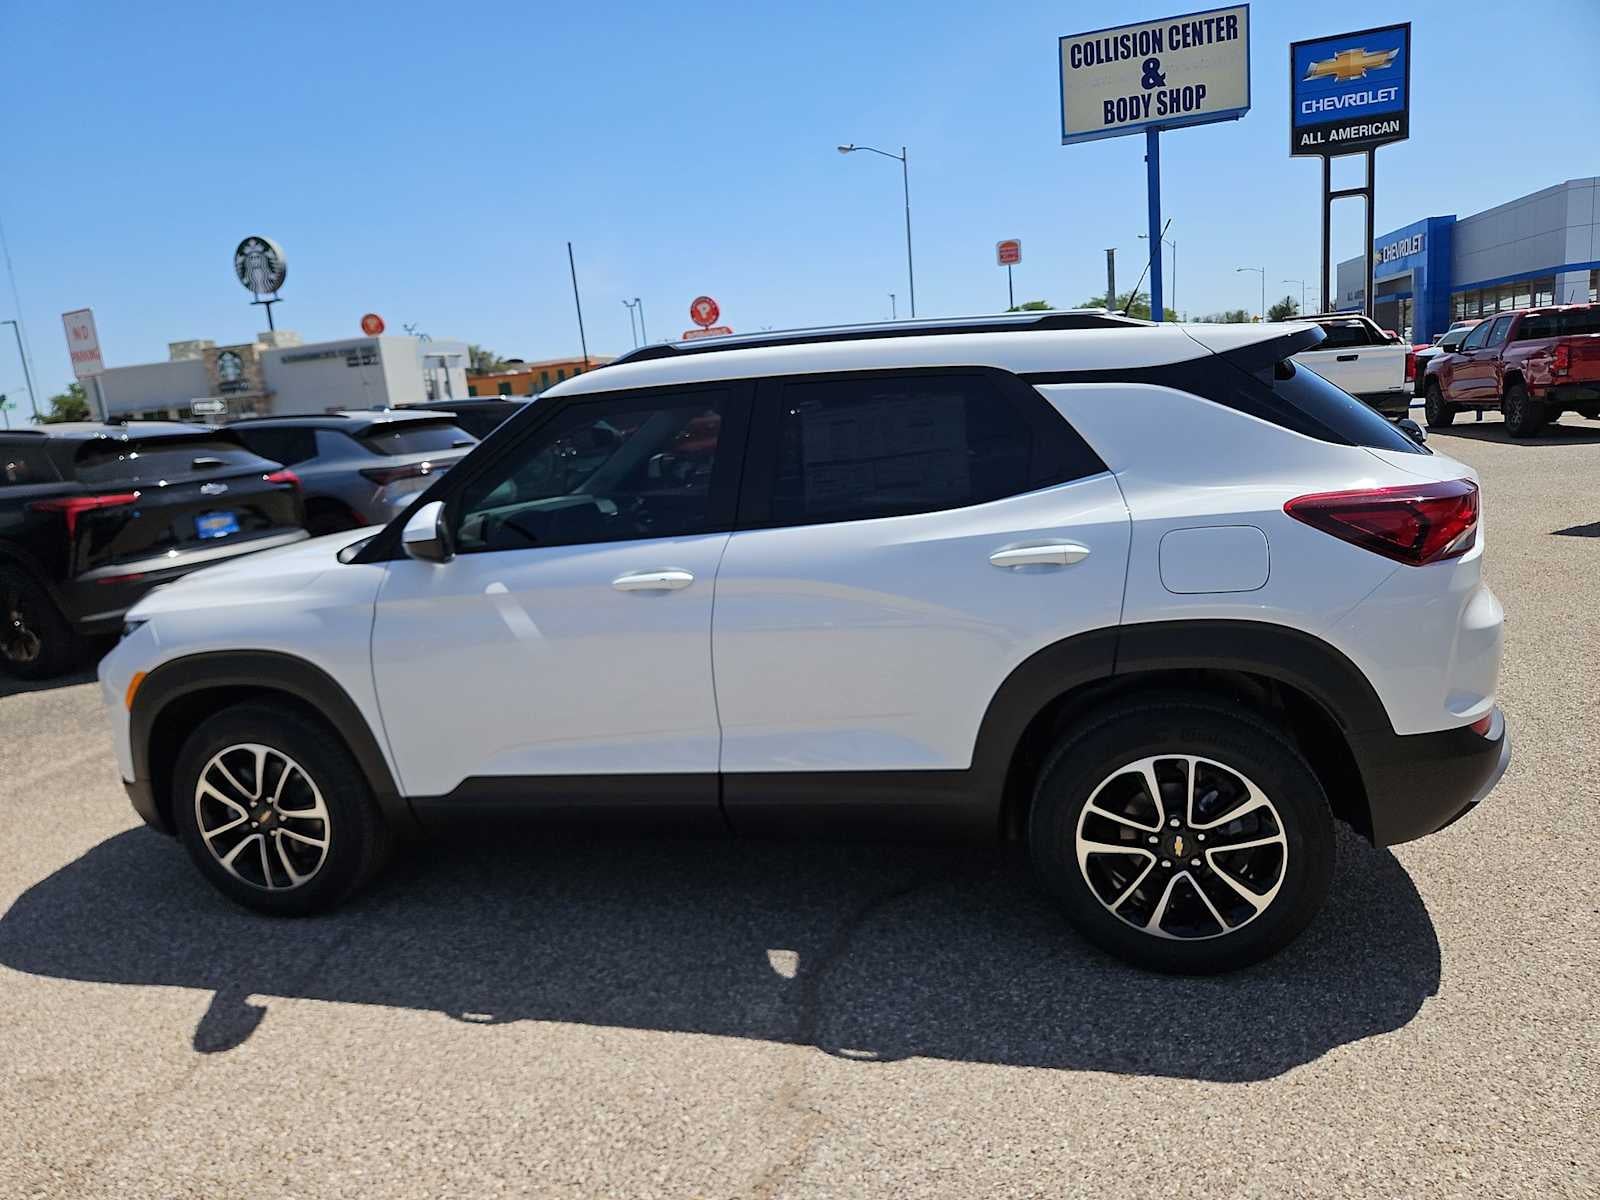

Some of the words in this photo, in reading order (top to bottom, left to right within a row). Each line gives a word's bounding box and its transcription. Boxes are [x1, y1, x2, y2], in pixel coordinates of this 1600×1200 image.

[1070, 28, 1164, 69] COLLISION
[1168, 14, 1238, 51] CENTER
[1141, 57, 1167, 90] &
[1103, 93, 1152, 125] BODY
[1156, 84, 1207, 116] SHOP
[1301, 87, 1399, 114] CHEVROLET
[1300, 132, 1326, 146] ALL
[1329, 120, 1400, 142] AMERICAN
[1383, 233, 1425, 263] CHEVROLET
